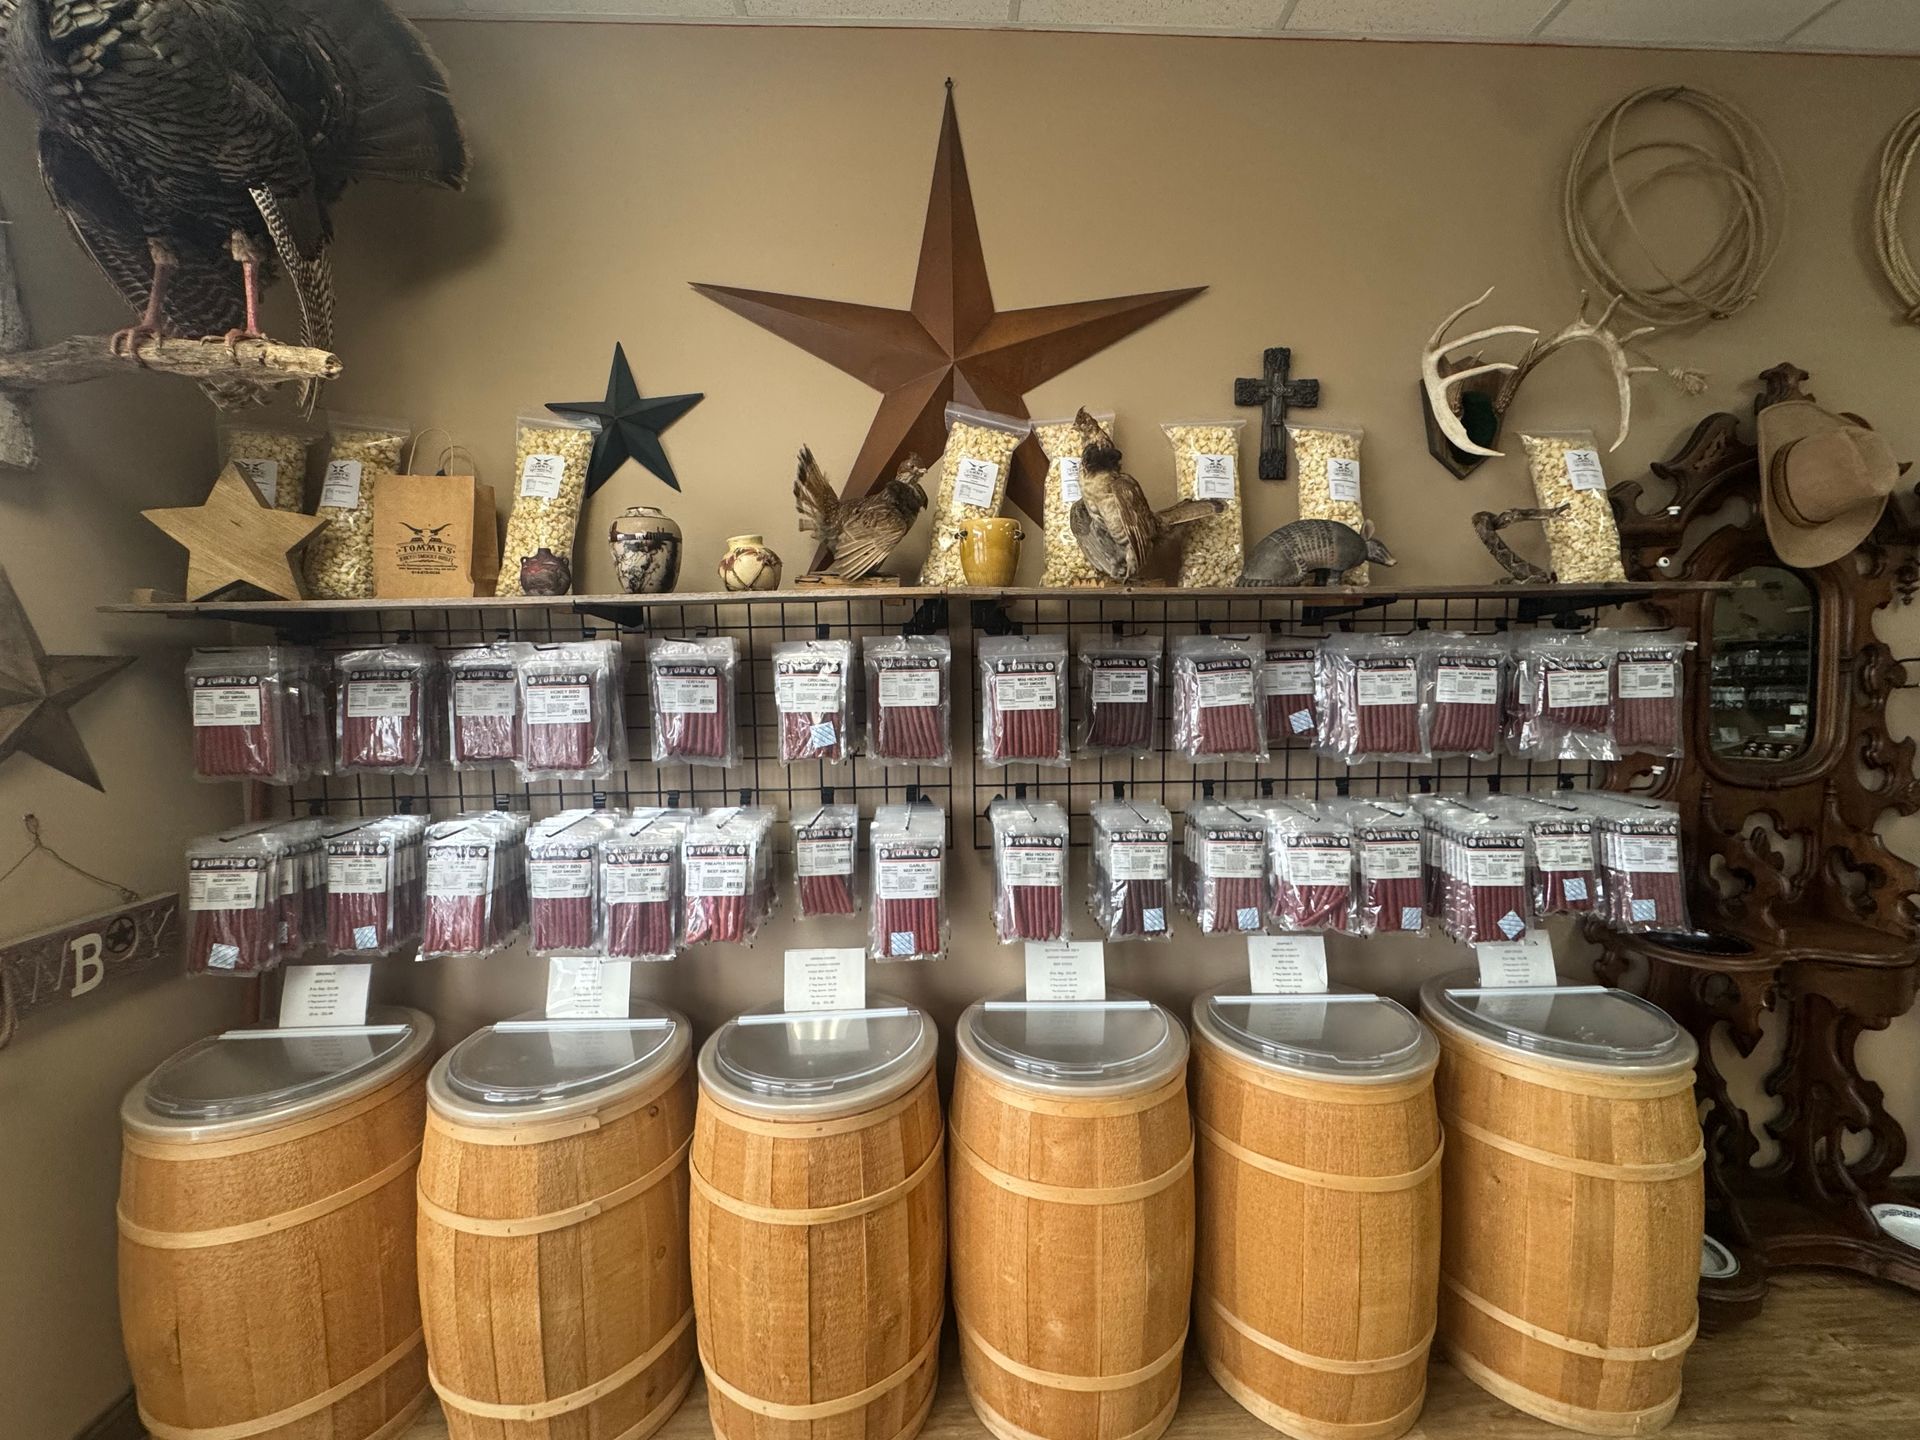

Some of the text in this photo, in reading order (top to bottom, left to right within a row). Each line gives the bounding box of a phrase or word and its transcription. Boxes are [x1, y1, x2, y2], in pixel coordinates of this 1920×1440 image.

[400, 545, 452, 554] TOMMY'S
[1269, 650, 1304, 660] TOMMY'S
[891, 659, 928, 668] TOMMY'S
[1007, 663, 1045, 672] TOMMY'S
[1205, 660, 1242, 670] TOMMY'S
[1367, 659, 1404, 668] TOMMY'S
[361, 670, 400, 679] TOMMY'S
[466, 670, 505, 679] TOMMY'S
[669, 666, 707, 676] TOMMY'S
[207, 676, 248, 686] TOMMY'S
[537, 675, 577, 684] TOMMY'S
[1632, 825, 1668, 834] TOMMY'S
[807, 830, 844, 839] TOMMY'S
[1120, 832, 1157, 841] TOMMY'S
[1218, 830, 1254, 840] TOMMY'S
[1374, 831, 1410, 840] TOMMY'S
[1014, 837, 1052, 846] TOMMY'S
[1298, 836, 1338, 847] TOMMY'S
[1478, 838, 1515, 847] TOMMY'S
[695, 845, 735, 855] TOMMY'S
[890, 848, 929, 858] TOMMY'S
[617, 853, 658, 864] TOMMY'S
[200, 859, 246, 868] TOMMY'S
